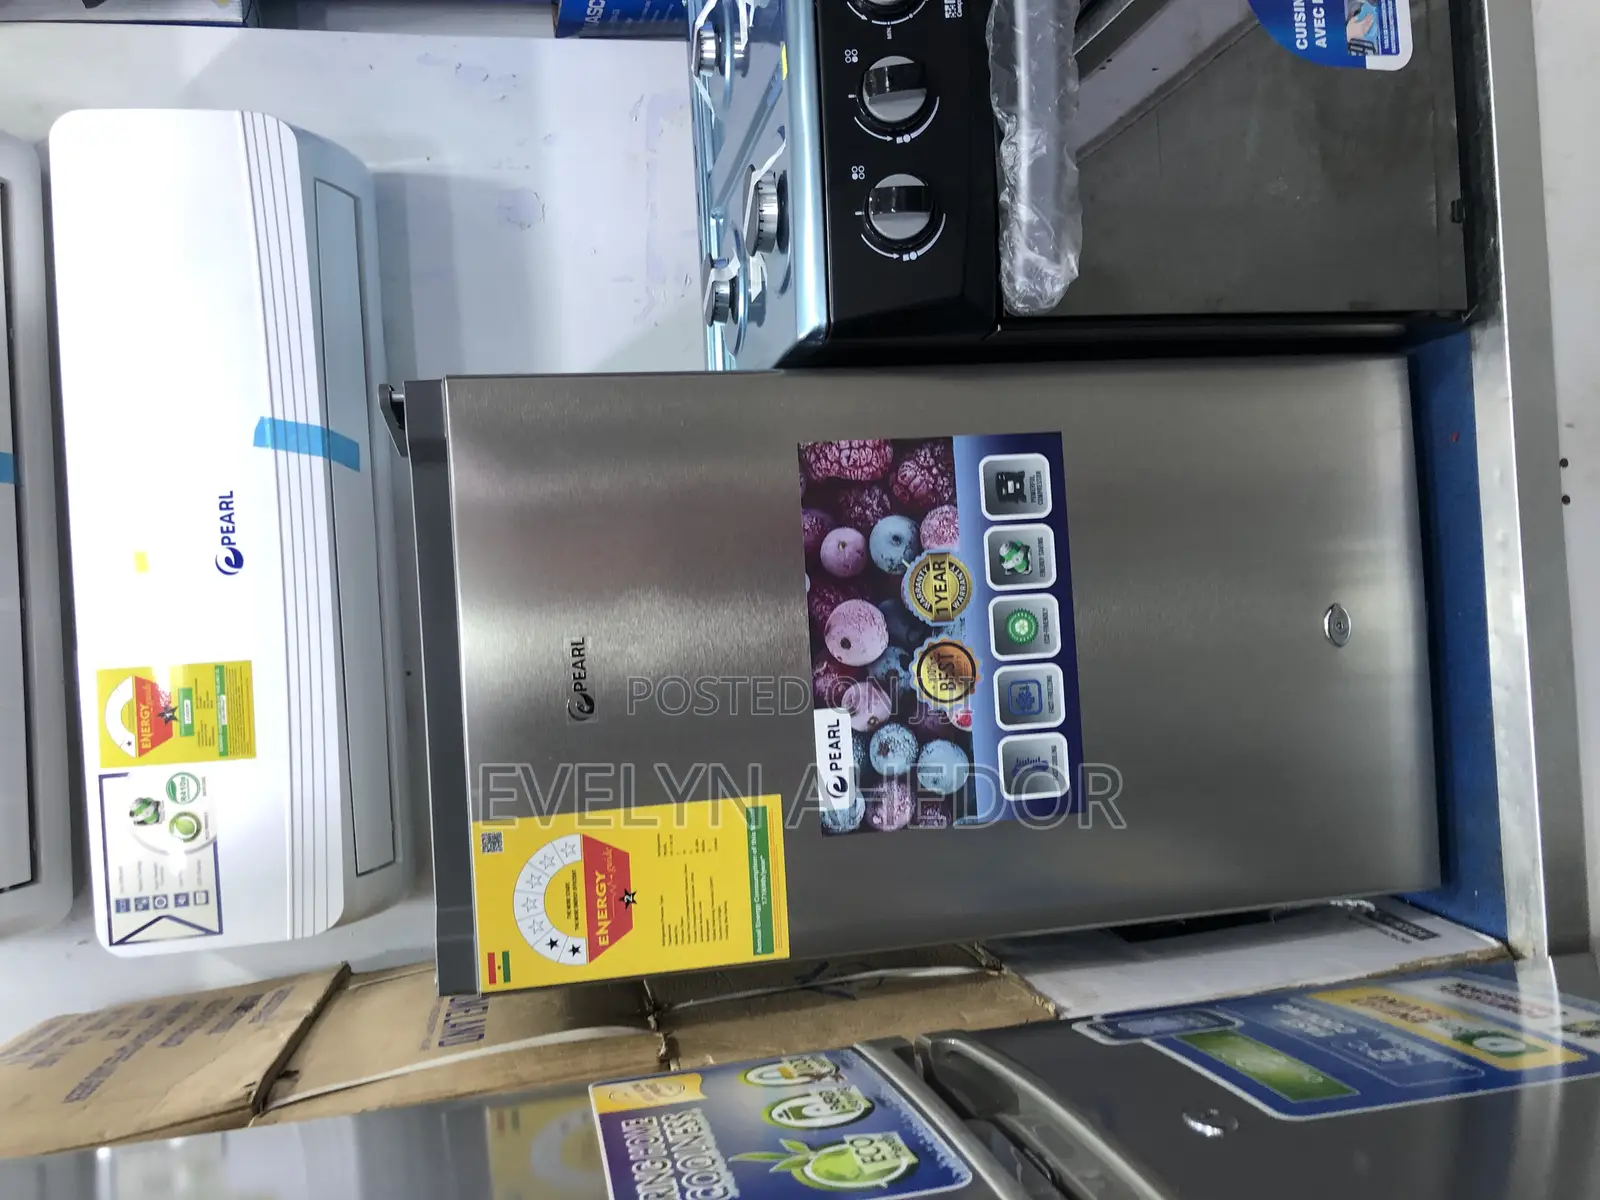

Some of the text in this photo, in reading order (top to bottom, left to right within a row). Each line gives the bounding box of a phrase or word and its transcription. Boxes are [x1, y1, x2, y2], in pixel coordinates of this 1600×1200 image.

[1312, 6, 1328, 48] AVEC
[1036, 470, 1044, 506] COMPRESSOR
[914, 565, 931, 611] WARRANTY
[933, 560, 948, 605] YEAR
[951, 563, 967, 609] WARRANTY
[1038, 556, 1046, 578] ENERGY
[937, 652, 956, 691] BEST
[139, 702, 153, 749] ENERGY
[826, 718, 843, 771] PEARL
[624, 894, 632, 902] 2
[752, 856, 760, 902] Consumption
[594, 870, 612, 946] ENERGY
[754, 904, 762, 928] Energy
[620, 1115, 675, 1160] HOME
[852, 1136, 890, 1165] ECO
